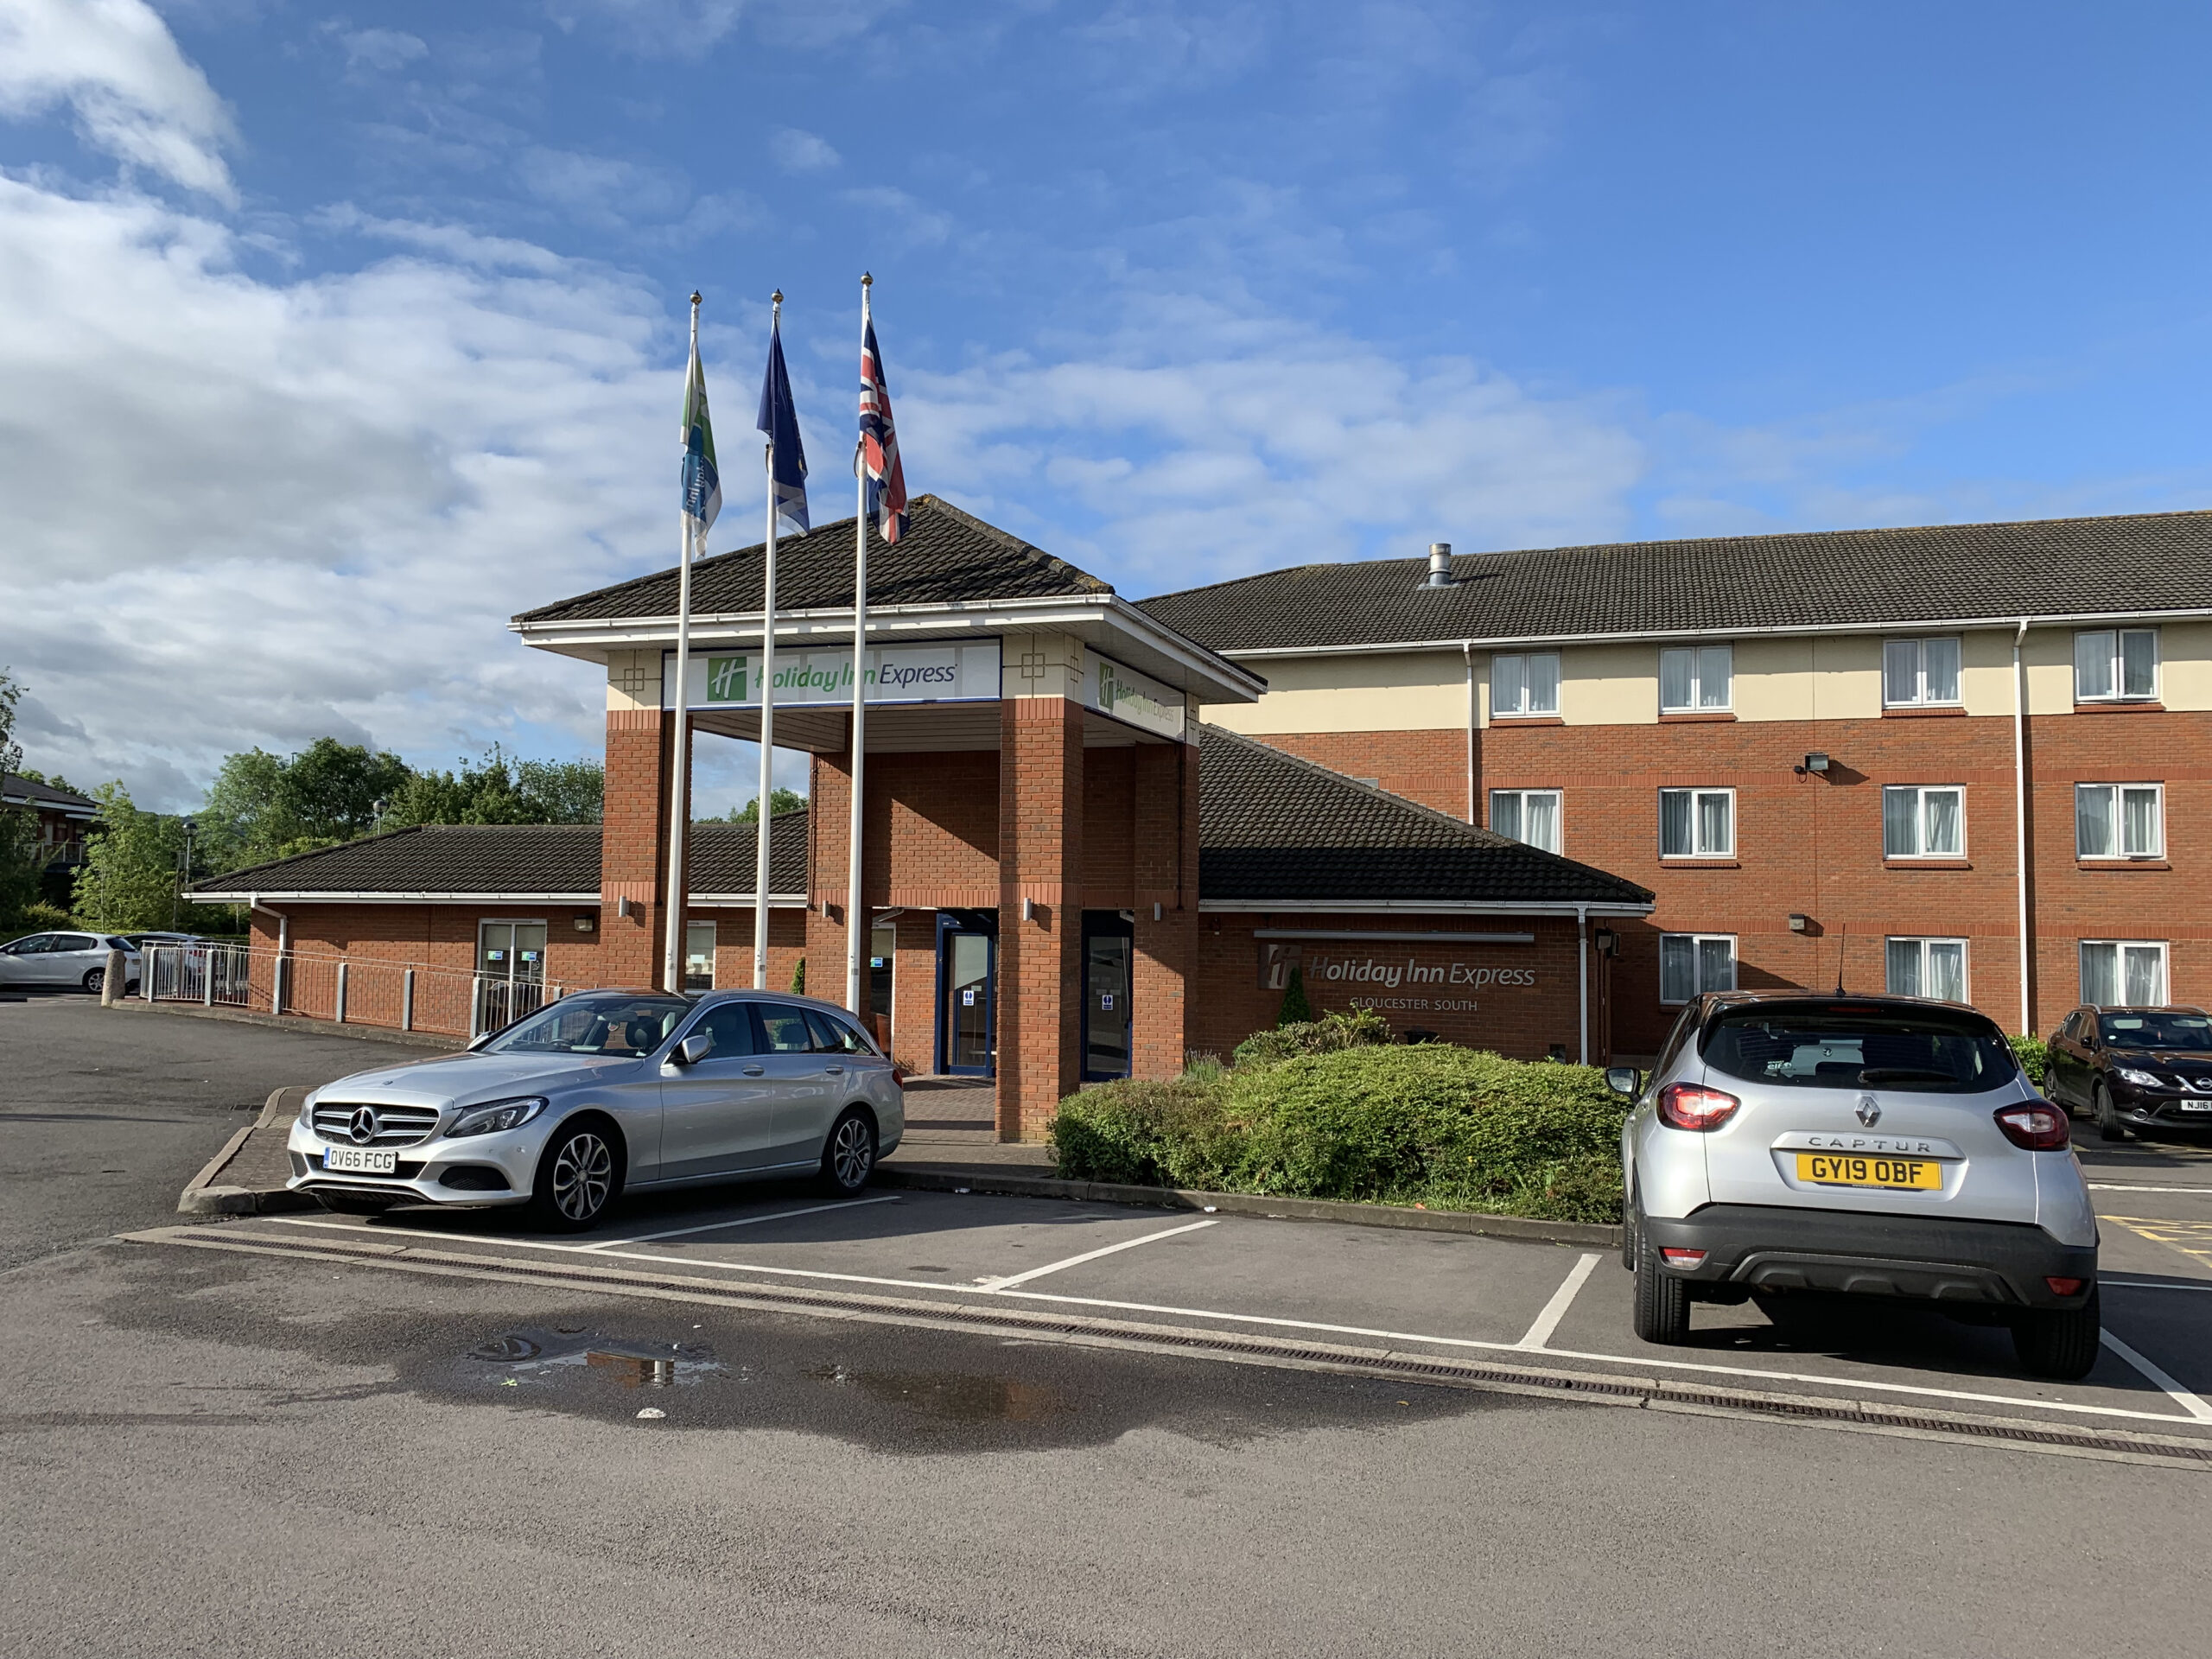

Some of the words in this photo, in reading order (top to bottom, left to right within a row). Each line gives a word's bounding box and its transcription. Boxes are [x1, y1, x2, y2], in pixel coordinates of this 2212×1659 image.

[880, 664, 955, 689] Express
[1309, 957, 1402, 988] Holiday
[1407, 958, 1445, 982] Inn
[1449, 963, 1535, 989] Express
[1350, 997, 1428, 1010] GLOUCESTER
[1434, 1000, 1478, 1011] SOUTH
[1808, 1137, 1930, 1153] CAPTUR
[365, 1152, 392, 1169] FCG
[1812, 1157, 1867, 1181] GY19
[1875, 1161, 1923, 1184] OBF
